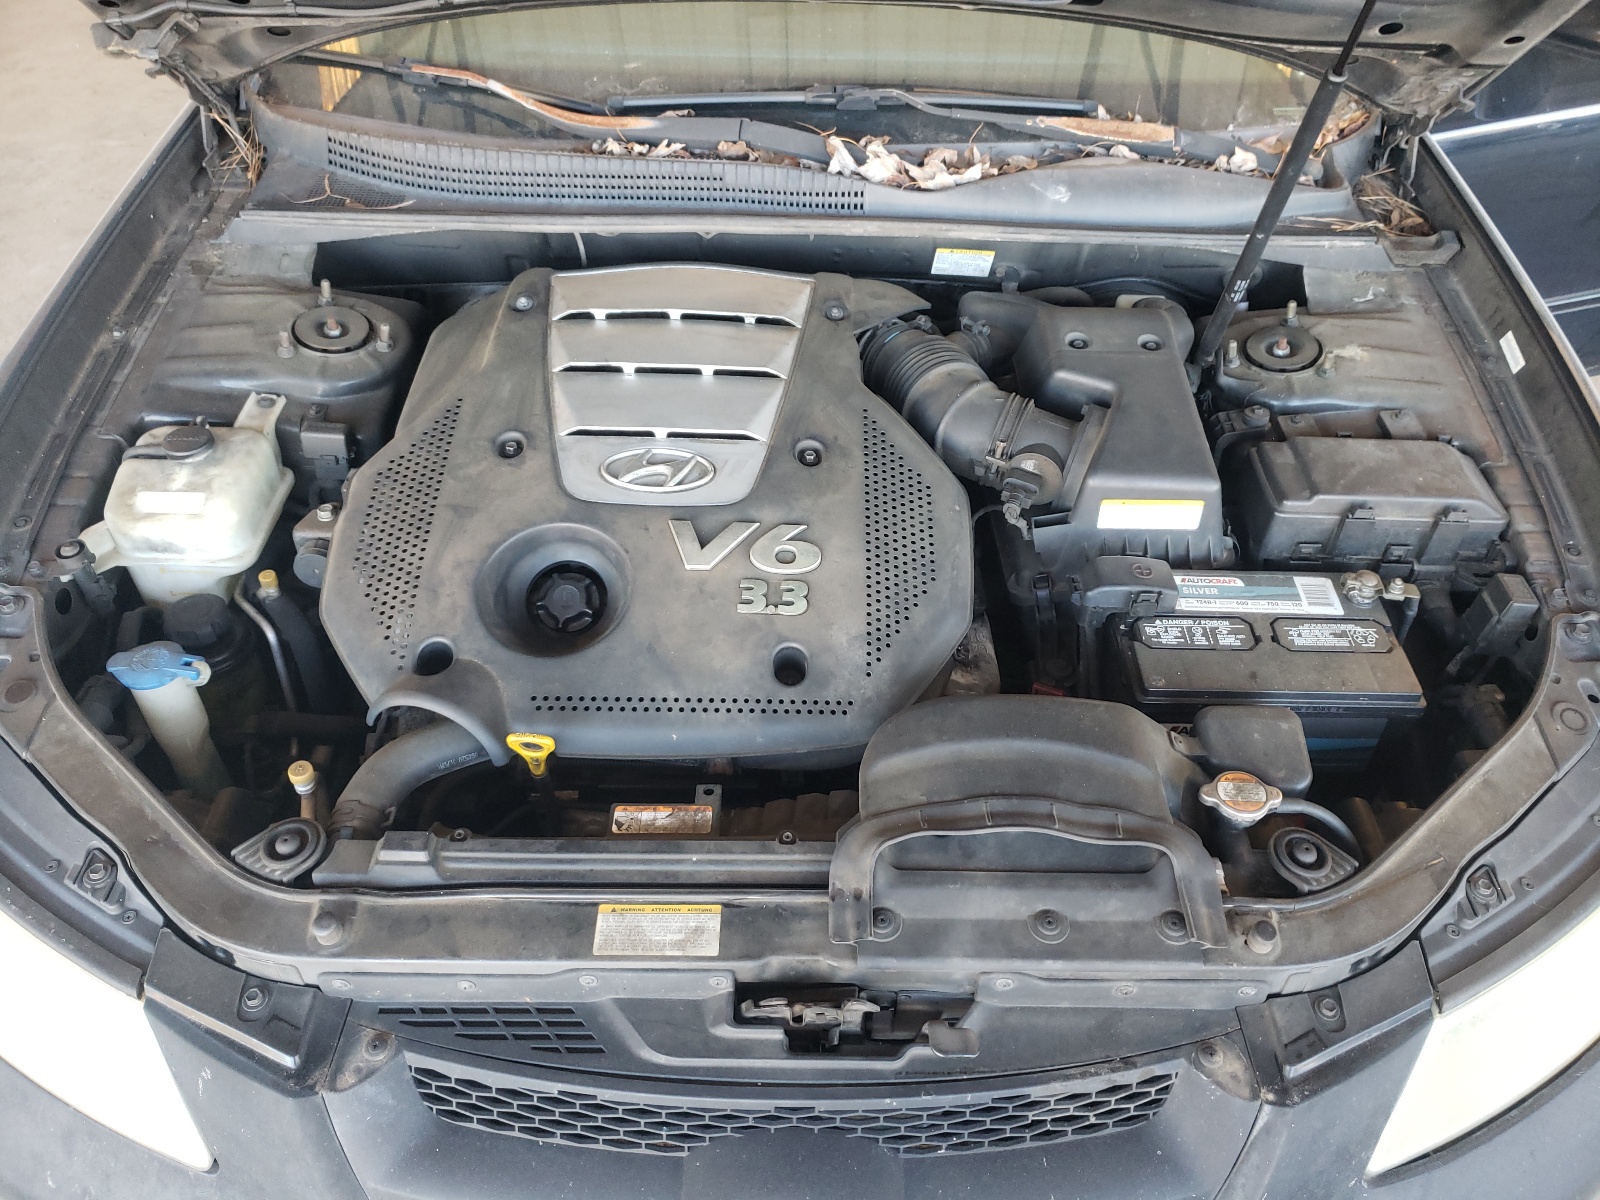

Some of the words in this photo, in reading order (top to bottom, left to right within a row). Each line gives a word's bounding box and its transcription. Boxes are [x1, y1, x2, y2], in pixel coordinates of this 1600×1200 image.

[668, 519, 822, 575] V6
[1182, 586, 1219, 595] SILVER
[1186, 577, 1239, 585] AUTOCRAFT
[736, 578, 809, 616] 3.3
